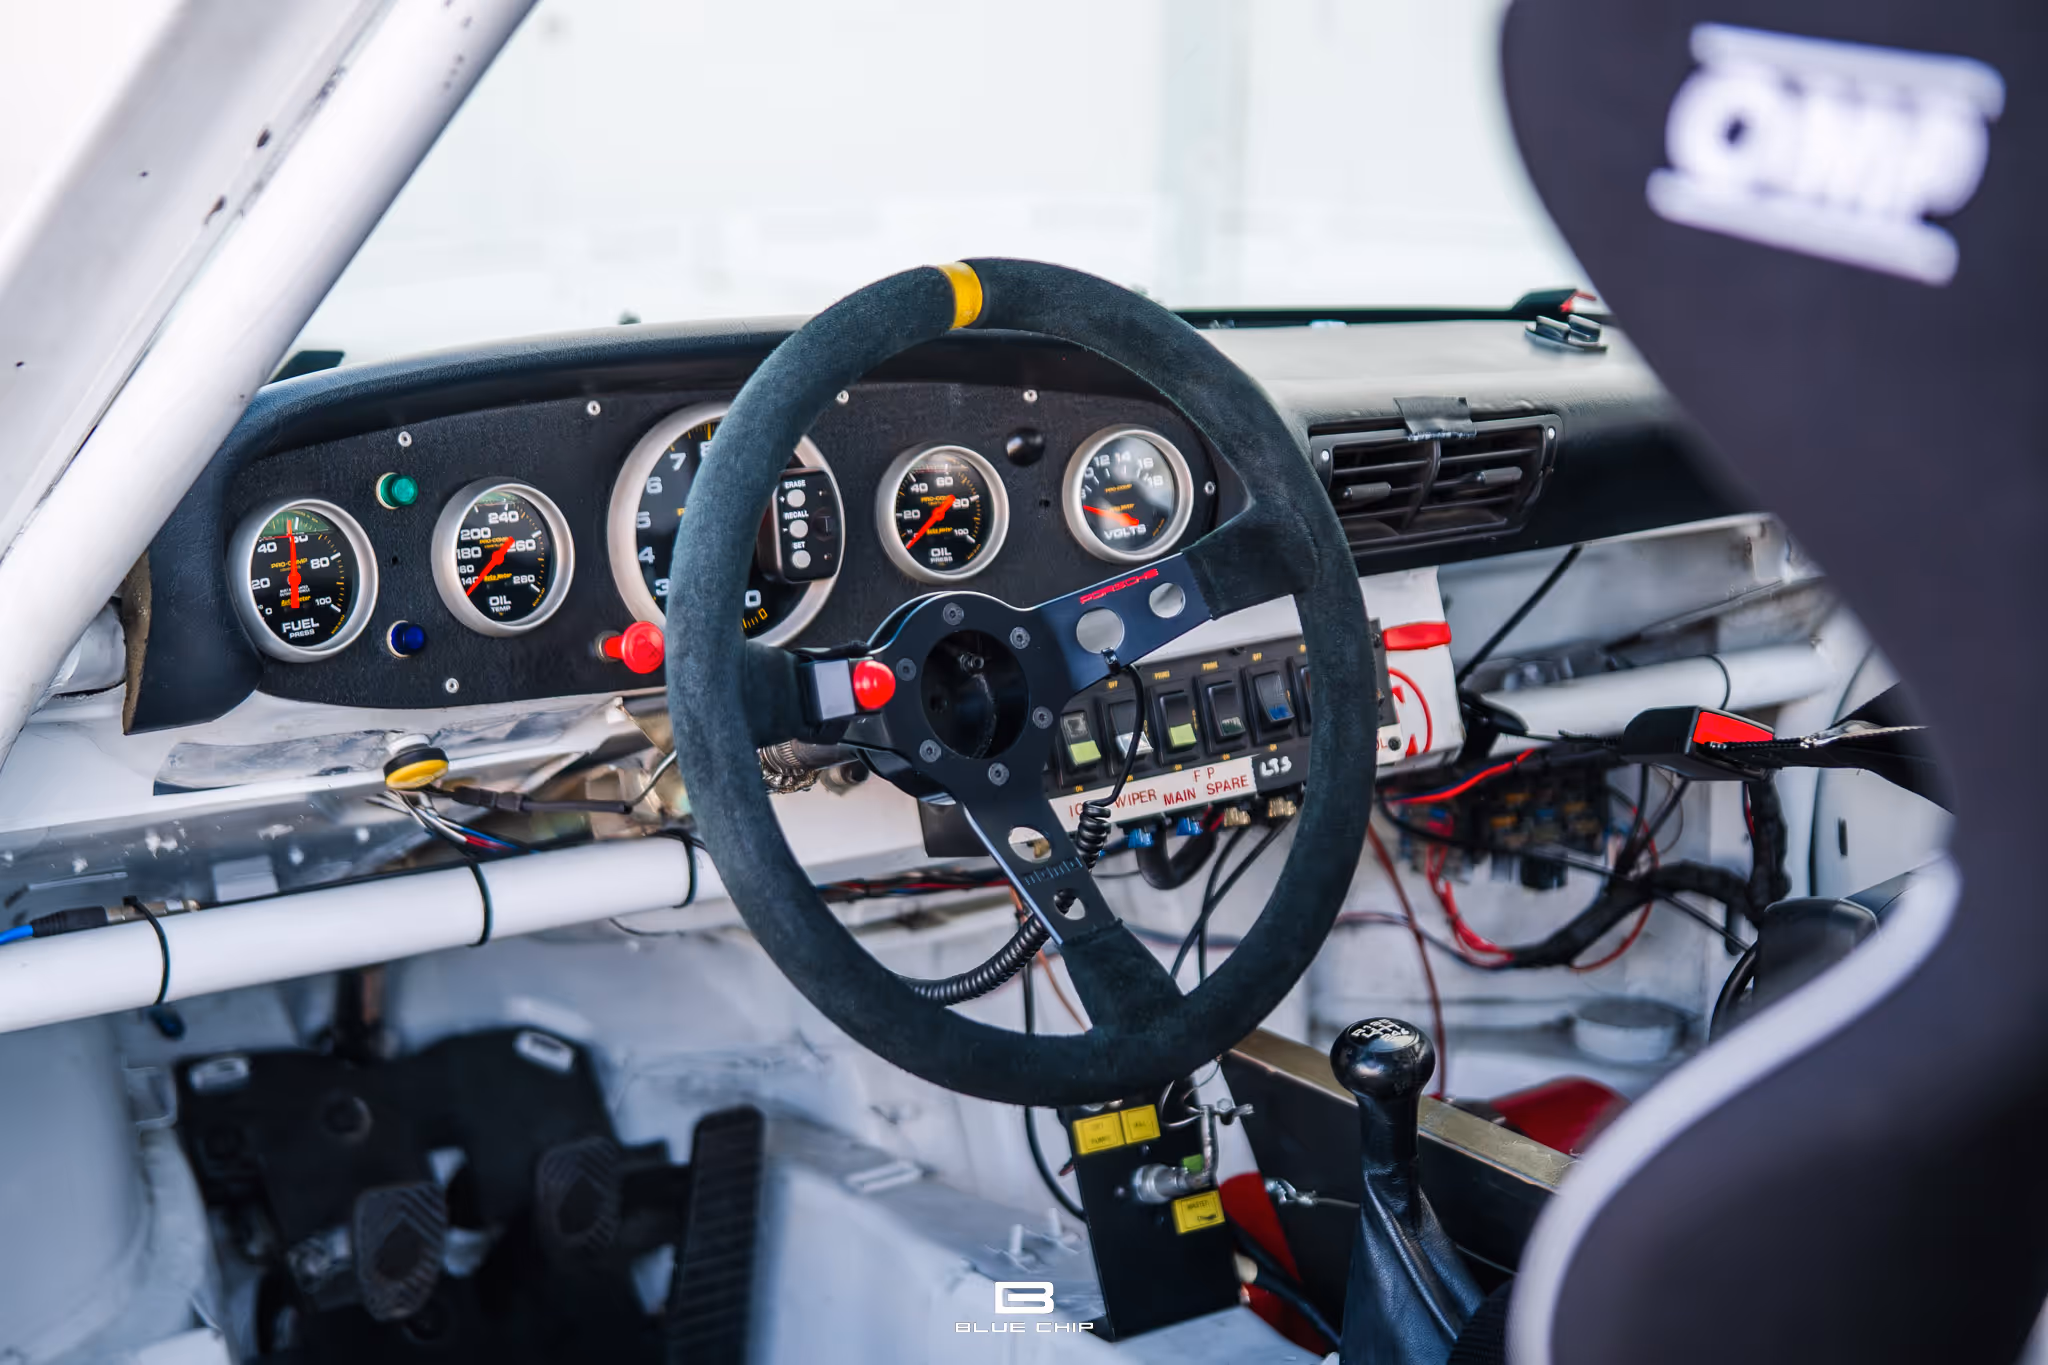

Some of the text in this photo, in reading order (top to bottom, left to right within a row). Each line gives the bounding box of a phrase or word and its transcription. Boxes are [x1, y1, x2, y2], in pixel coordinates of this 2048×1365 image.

[670, 452, 686, 471] 7
[1094, 454, 1110, 467] 12
[646, 476, 663, 494] 6
[784, 479, 806, 489] ERASE
[910, 483, 928, 493] 40
[936, 476, 954, 487] 60
[952, 498, 970, 508] 80
[488, 510, 519, 525] 240
[636, 511, 651, 529] 5
[783, 510, 809, 520] RECALL
[903, 509, 920, 519] 20
[460, 527, 491, 541] 200
[954, 528, 969, 536] 100
[1104, 524, 1146, 540] VOLTS
[257, 541, 278, 554] 40
[507, 538, 536, 553] 260
[792, 541, 806, 550] SET
[930, 547, 952, 557] OIL
[457, 546, 482, 560] 180
[638, 546, 655, 564] 4
[270, 557, 308, 569] PRO-CMP
[310, 556, 330, 570] 80
[251, 577, 271, 590] 20
[513, 574, 535, 585] 280
[655, 578, 669, 596] 3
[1079, 568, 1159, 605] PORSCHE
[315, 596, 332, 606] 100
[489, 595, 512, 607] OIL
[745, 590, 762, 607] 0
[265, 607, 273, 615] 0
[491, 605, 511, 613] TEMP
[282, 617, 320, 634] FUEL
[289, 629, 316, 639] PRESS
[1114, 788, 1158, 809] WIPER
[1163, 787, 1197, 807] MAIN
[1206, 774, 1250, 796] SPARE
